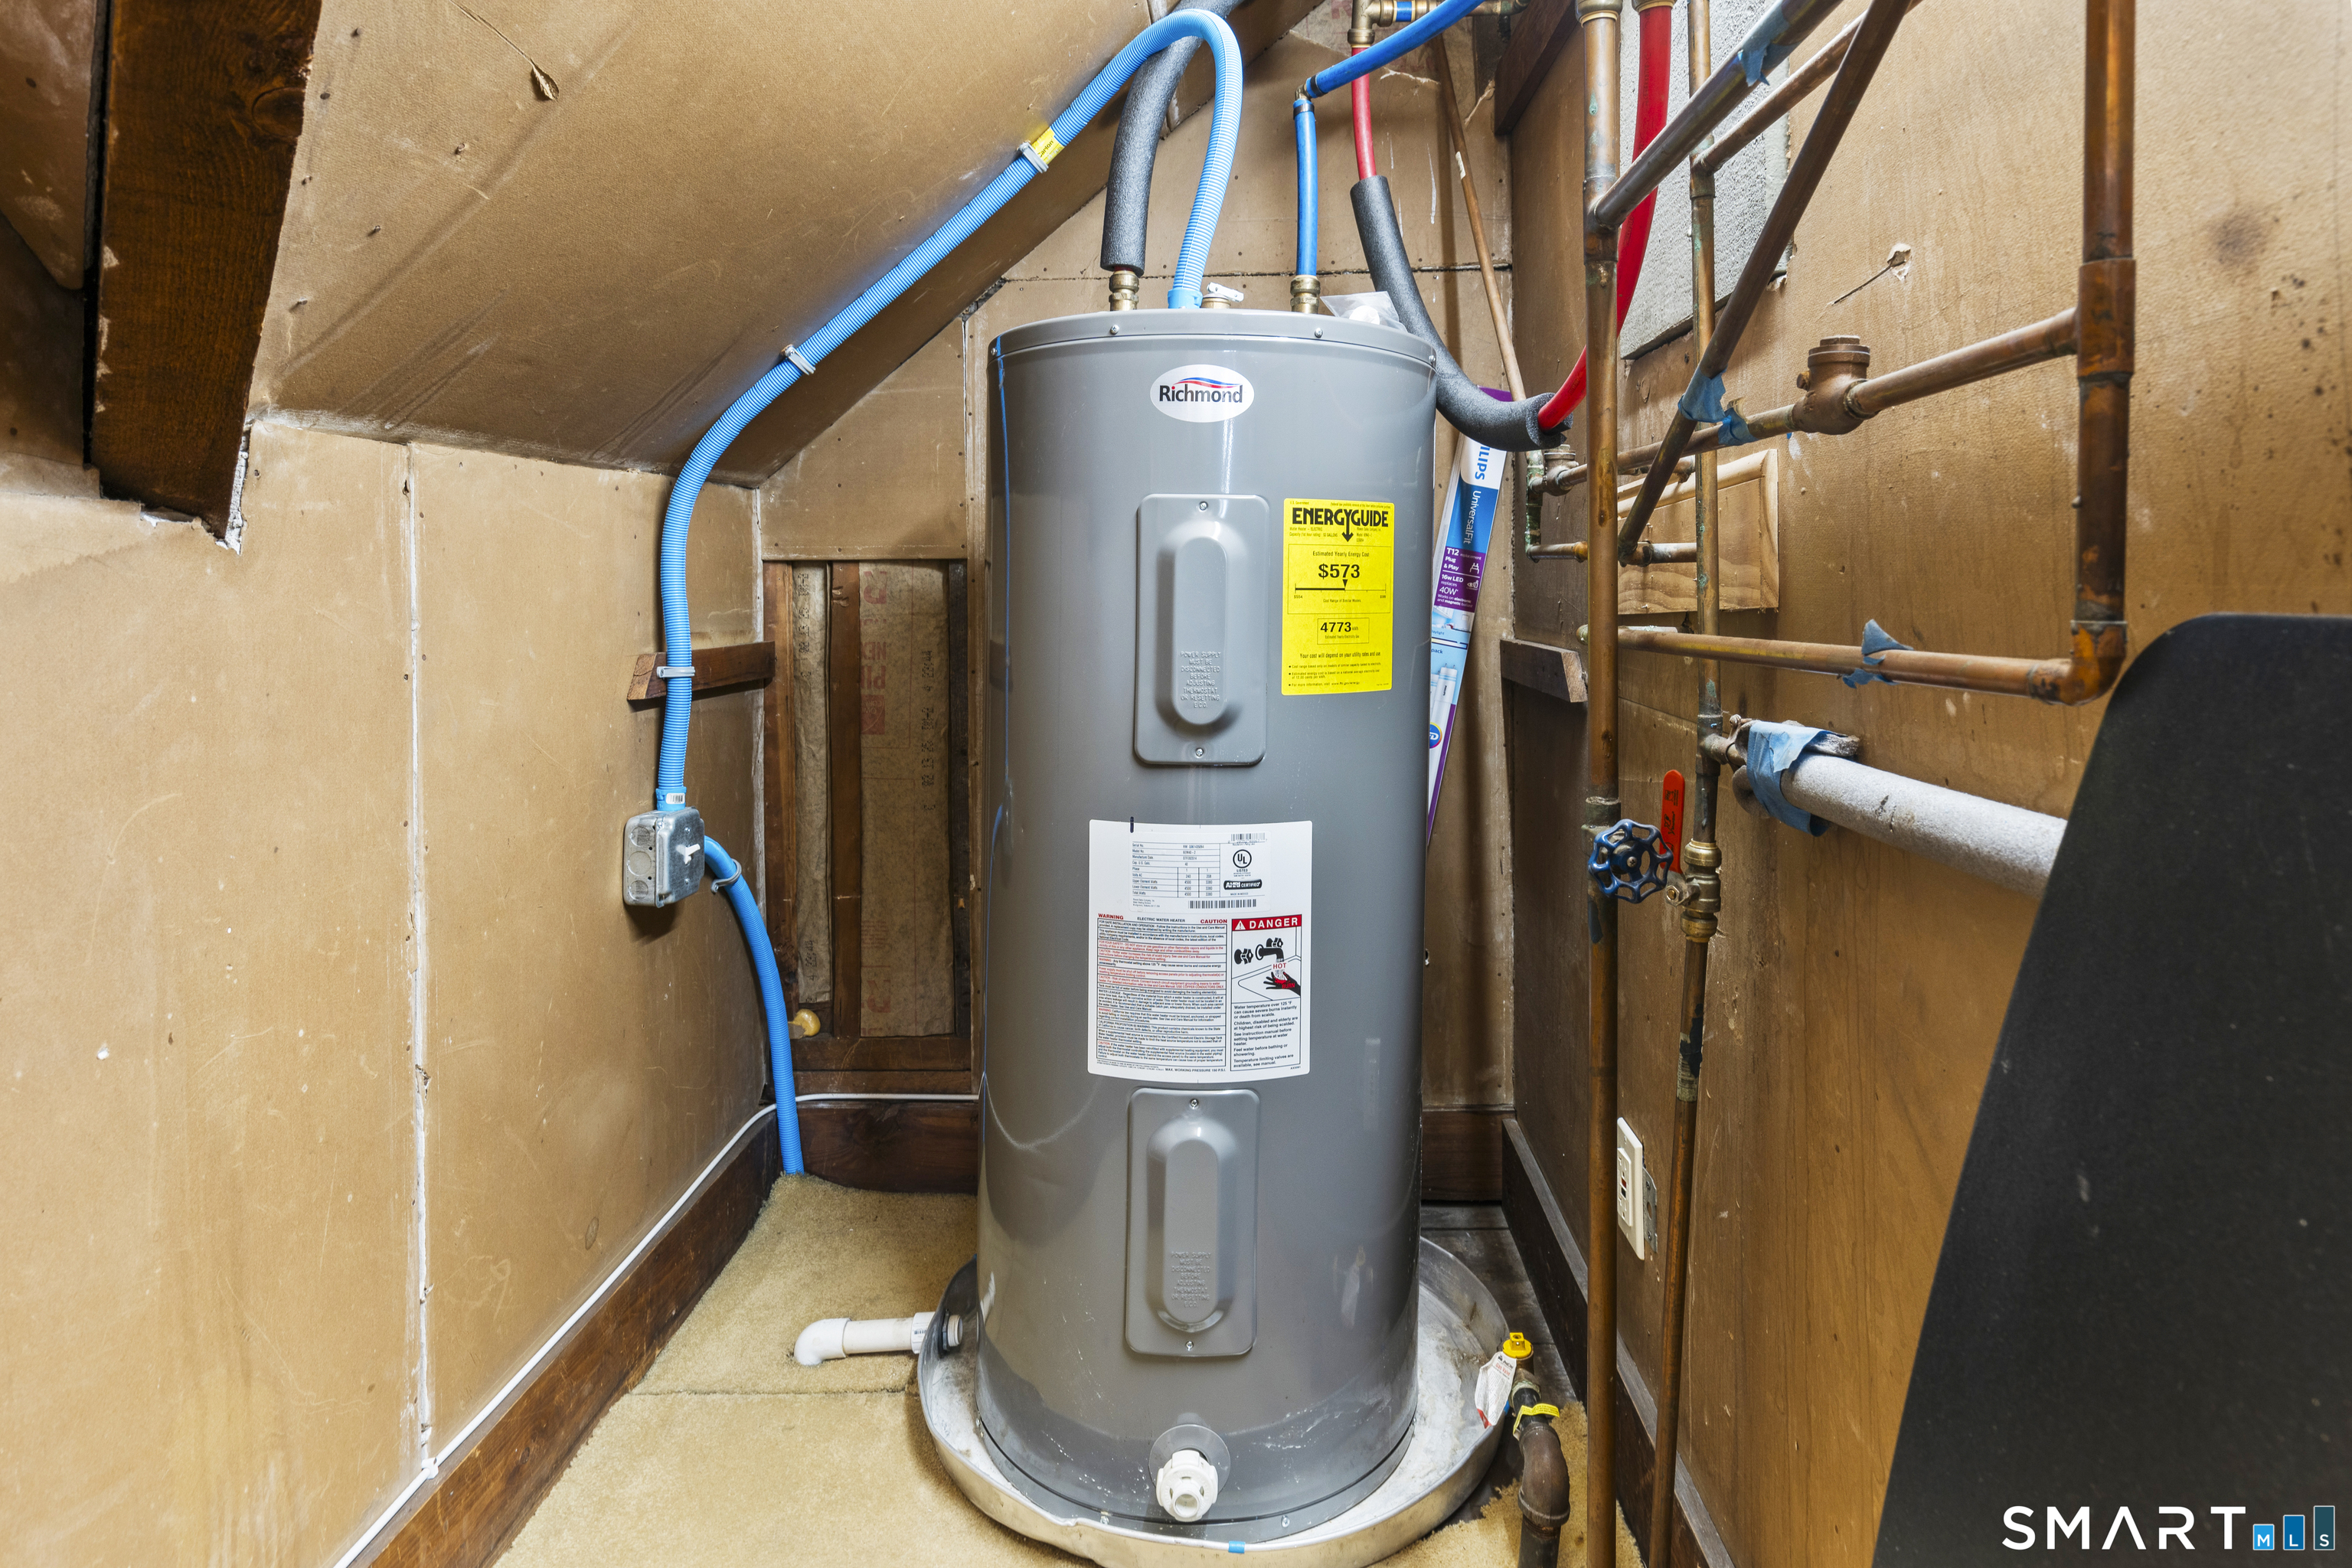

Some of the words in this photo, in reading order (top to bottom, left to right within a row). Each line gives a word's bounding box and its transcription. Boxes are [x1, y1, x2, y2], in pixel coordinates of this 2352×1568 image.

[1159, 384, 1243, 403] Richmond
[1475, 446, 1490, 480] ILIPS
[1292, 508, 1388, 528] ENERGYGUIDE
[1463, 491, 1481, 544] UniversalFit
[1446, 547, 1459, 556] T12
[1318, 564, 1361, 580] $573
[1321, 622, 1353, 632] 4773
[1237, 854, 1247, 864] UL
[1250, 917, 1298, 929] DANGER
